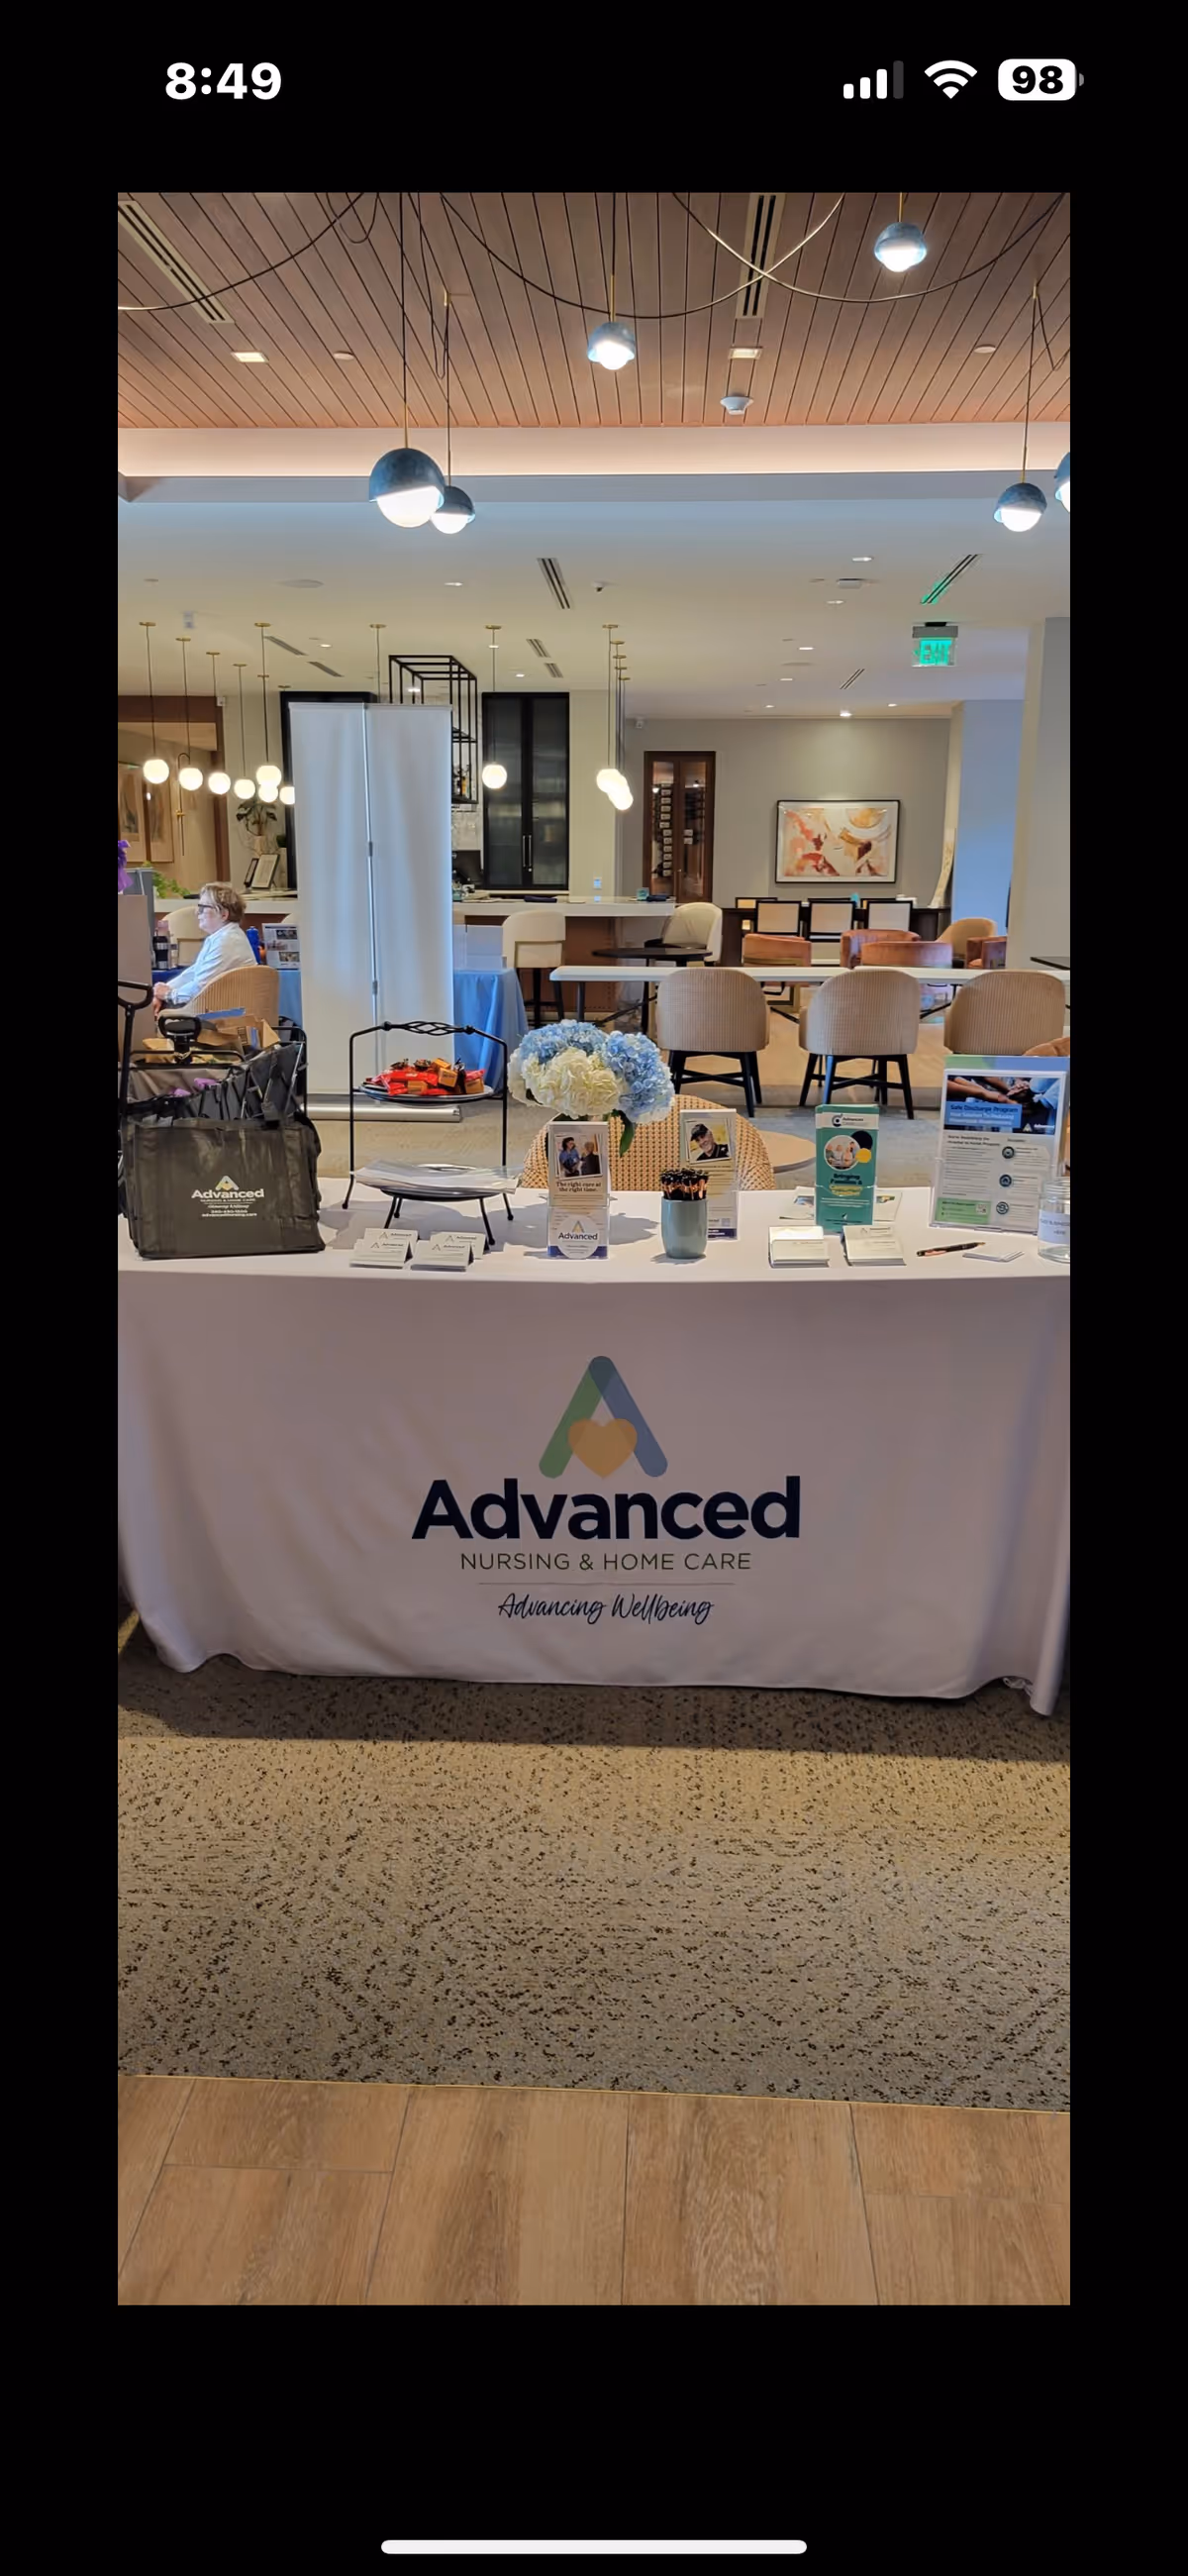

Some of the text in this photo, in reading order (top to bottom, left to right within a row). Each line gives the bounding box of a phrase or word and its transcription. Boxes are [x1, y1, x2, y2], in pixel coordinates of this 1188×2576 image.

[920, 640, 951, 665] EXIT
[191, 1188, 264, 1198] Advanced
[412, 1476, 800, 1540] Advanced
[460, 1552, 752, 1572] NURSING & HOME CARE
[498, 1593, 715, 1626] Advancing Wellbeing
